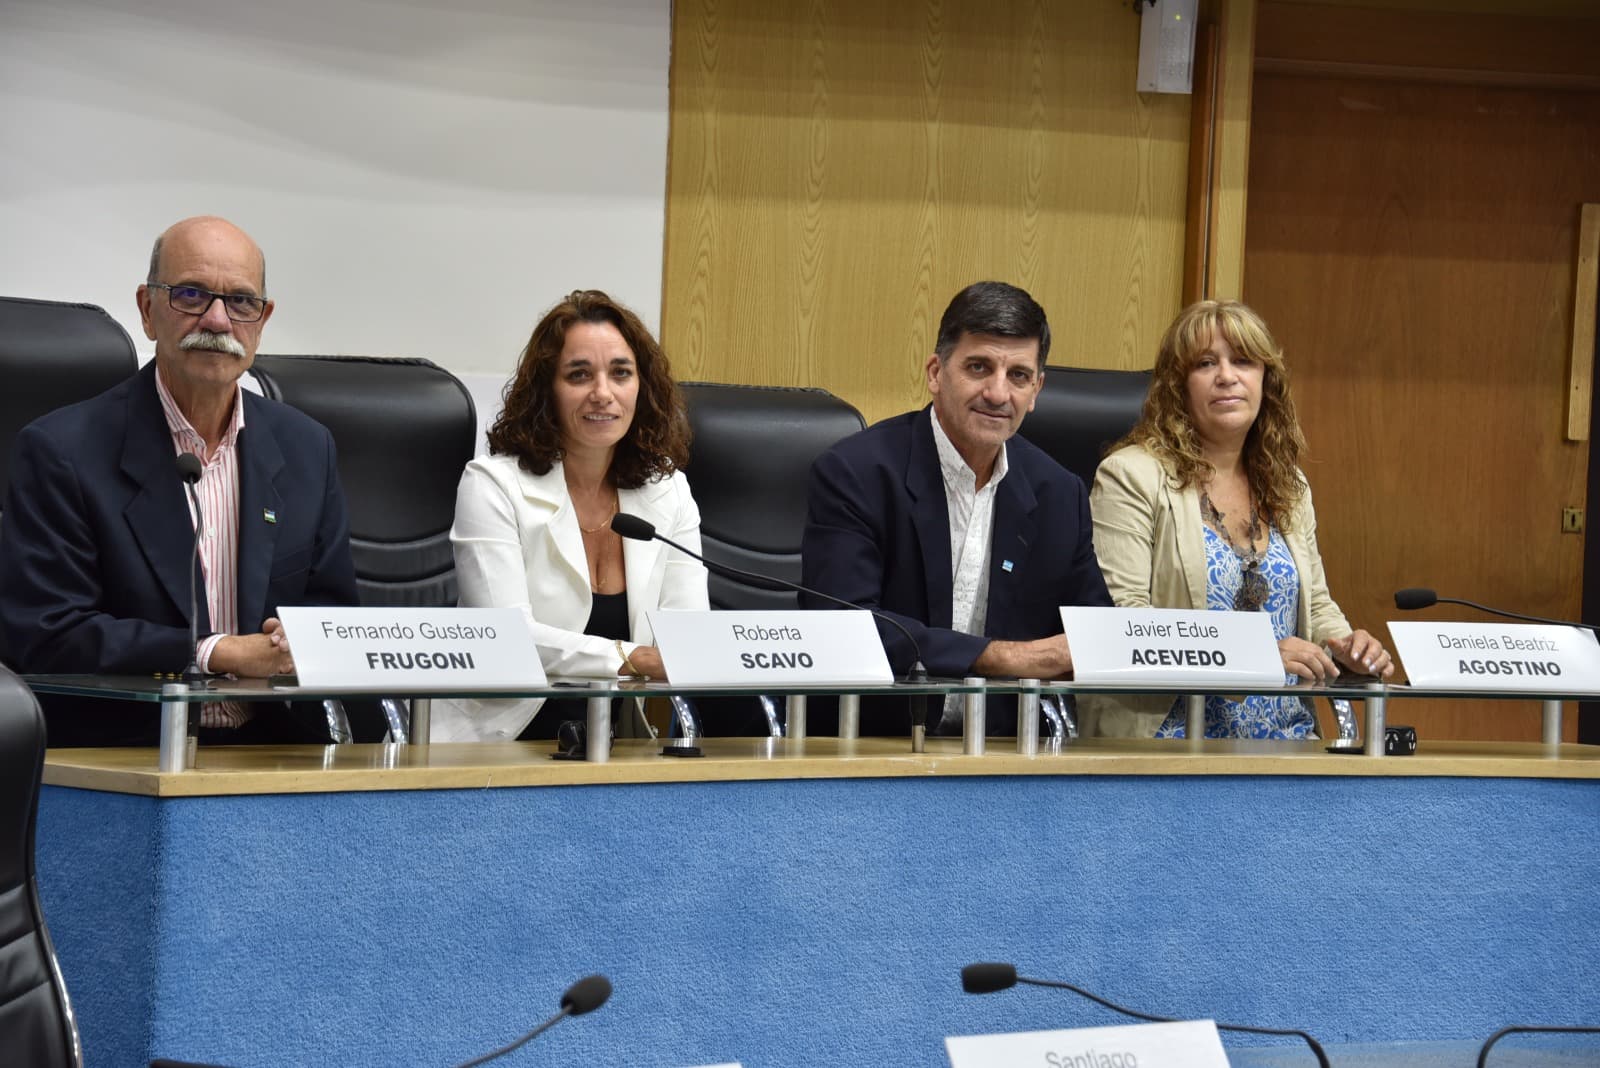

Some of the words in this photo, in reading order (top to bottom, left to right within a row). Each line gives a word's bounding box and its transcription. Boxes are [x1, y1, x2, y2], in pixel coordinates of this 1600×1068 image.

[321, 621, 414, 640] Fernando
[418, 622, 497, 640] Gustavo
[731, 624, 802, 641] Roberta
[1125, 619, 1172, 638] Javier
[1175, 620, 1220, 639] Edue
[1437, 634, 1500, 650] Daniela
[1501, 635, 1560, 652] Beatriz
[365, 651, 476, 670] FRUGONI
[740, 651, 814, 669] SCAVO
[1131, 648, 1227, 667] ACEVEDO
[1459, 659, 1562, 676] AGOSTINO
[1045, 1049, 1138, 1068] Santiago
